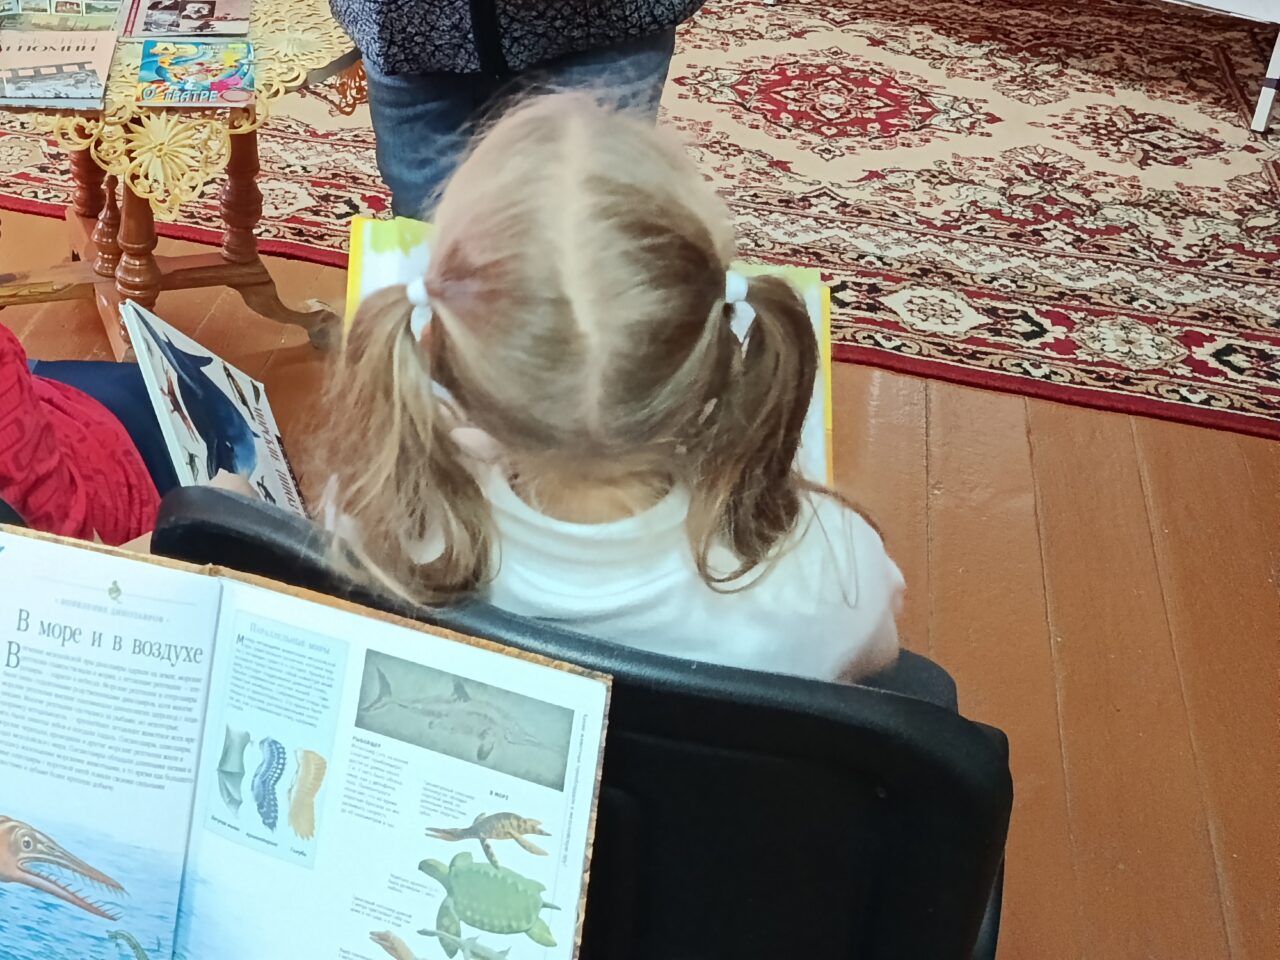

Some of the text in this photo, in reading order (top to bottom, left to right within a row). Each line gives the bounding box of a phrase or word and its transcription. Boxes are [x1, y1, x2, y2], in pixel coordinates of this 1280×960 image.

[142, 86, 218, 102] О ТЕАТРЕ
[16, 608, 204, 668] В море и в воздухе
[4, 640, 21, 669] В
